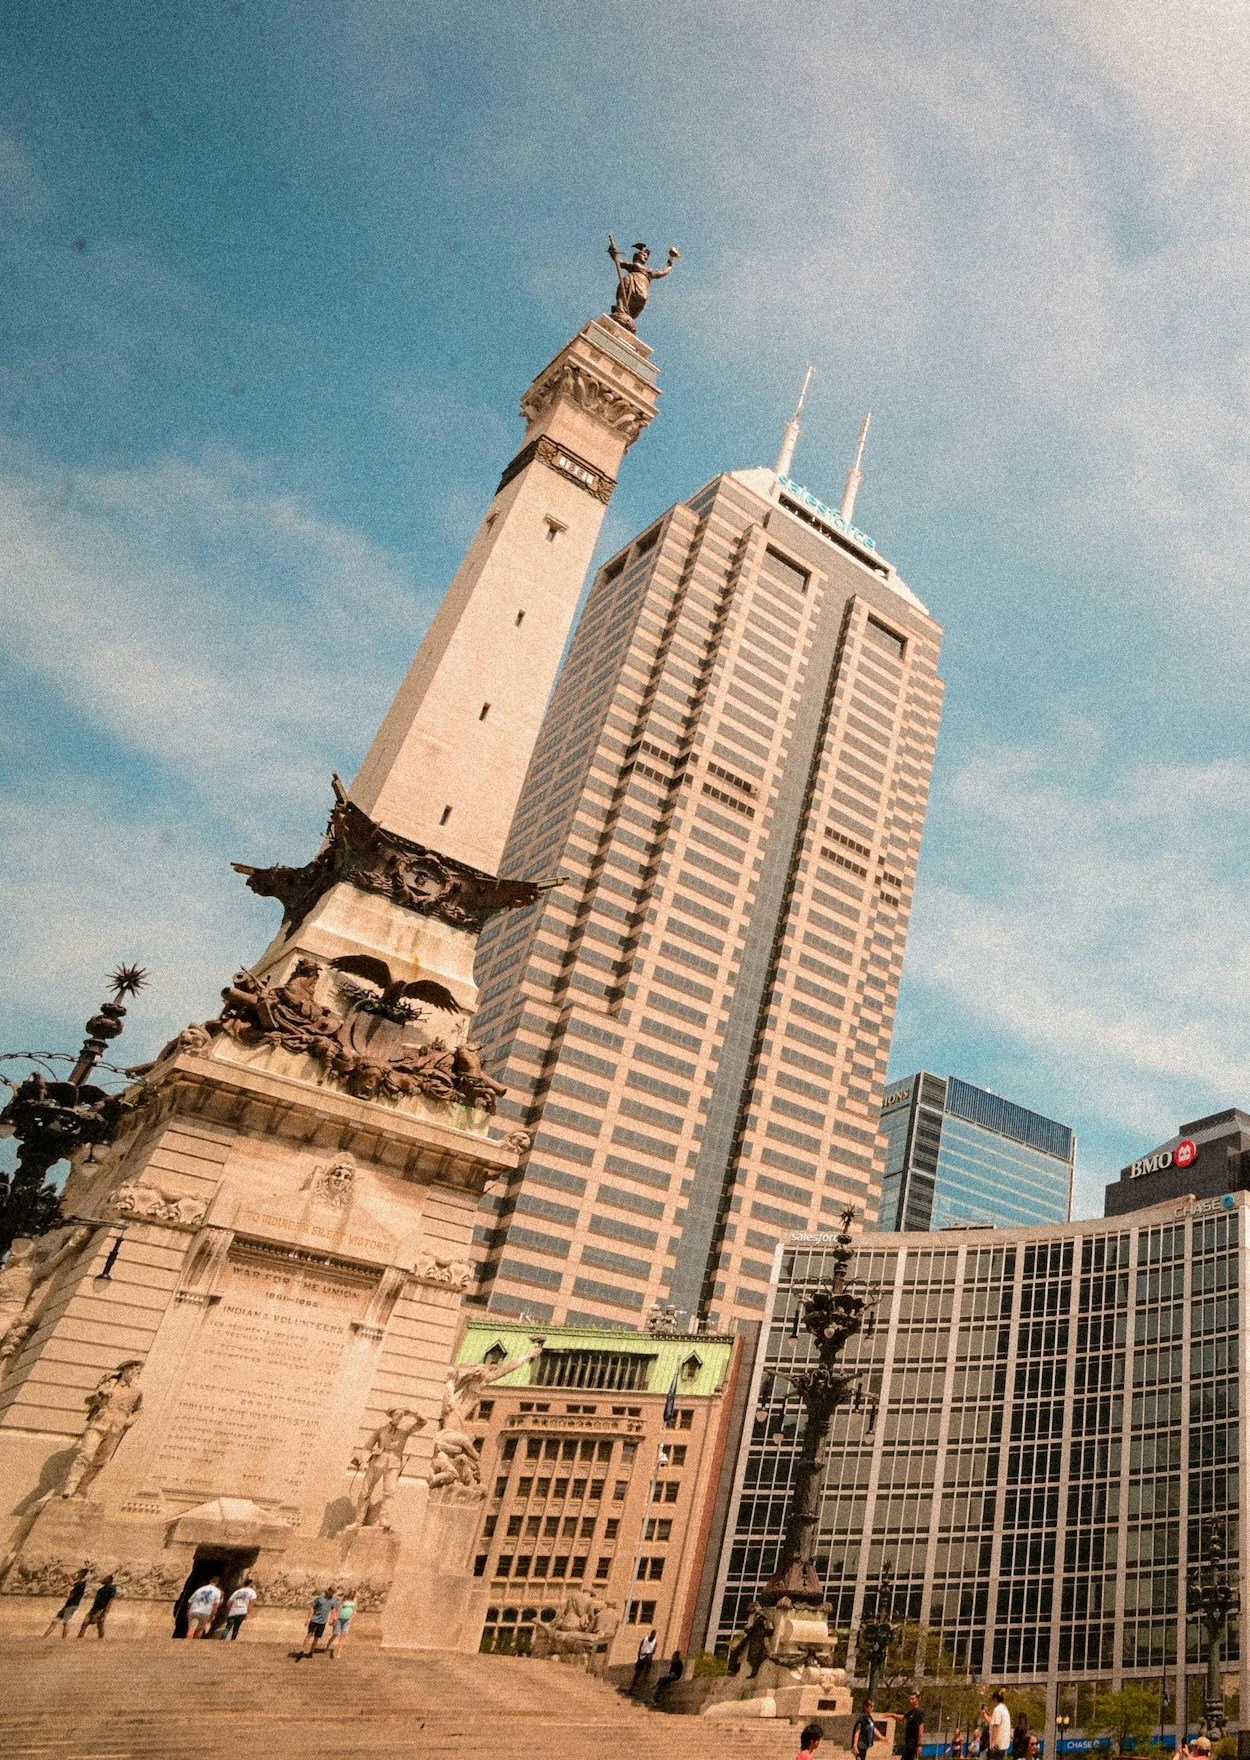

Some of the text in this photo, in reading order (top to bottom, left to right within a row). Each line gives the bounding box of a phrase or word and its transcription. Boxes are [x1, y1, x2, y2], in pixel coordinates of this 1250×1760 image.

[778, 475, 876, 549] salesforce
[1130, 1151, 1173, 1179] BMO
[1174, 1197, 1221, 1218] CHASE
[233, 1266, 261, 1278] WAR
[265, 1273, 290, 1284] FOR
[322, 1285, 361, 1299] UNION
[223, 1305, 345, 1334] INDIANA VOLUNTEERS
[1067, 1741, 1093, 1749] CHASE
